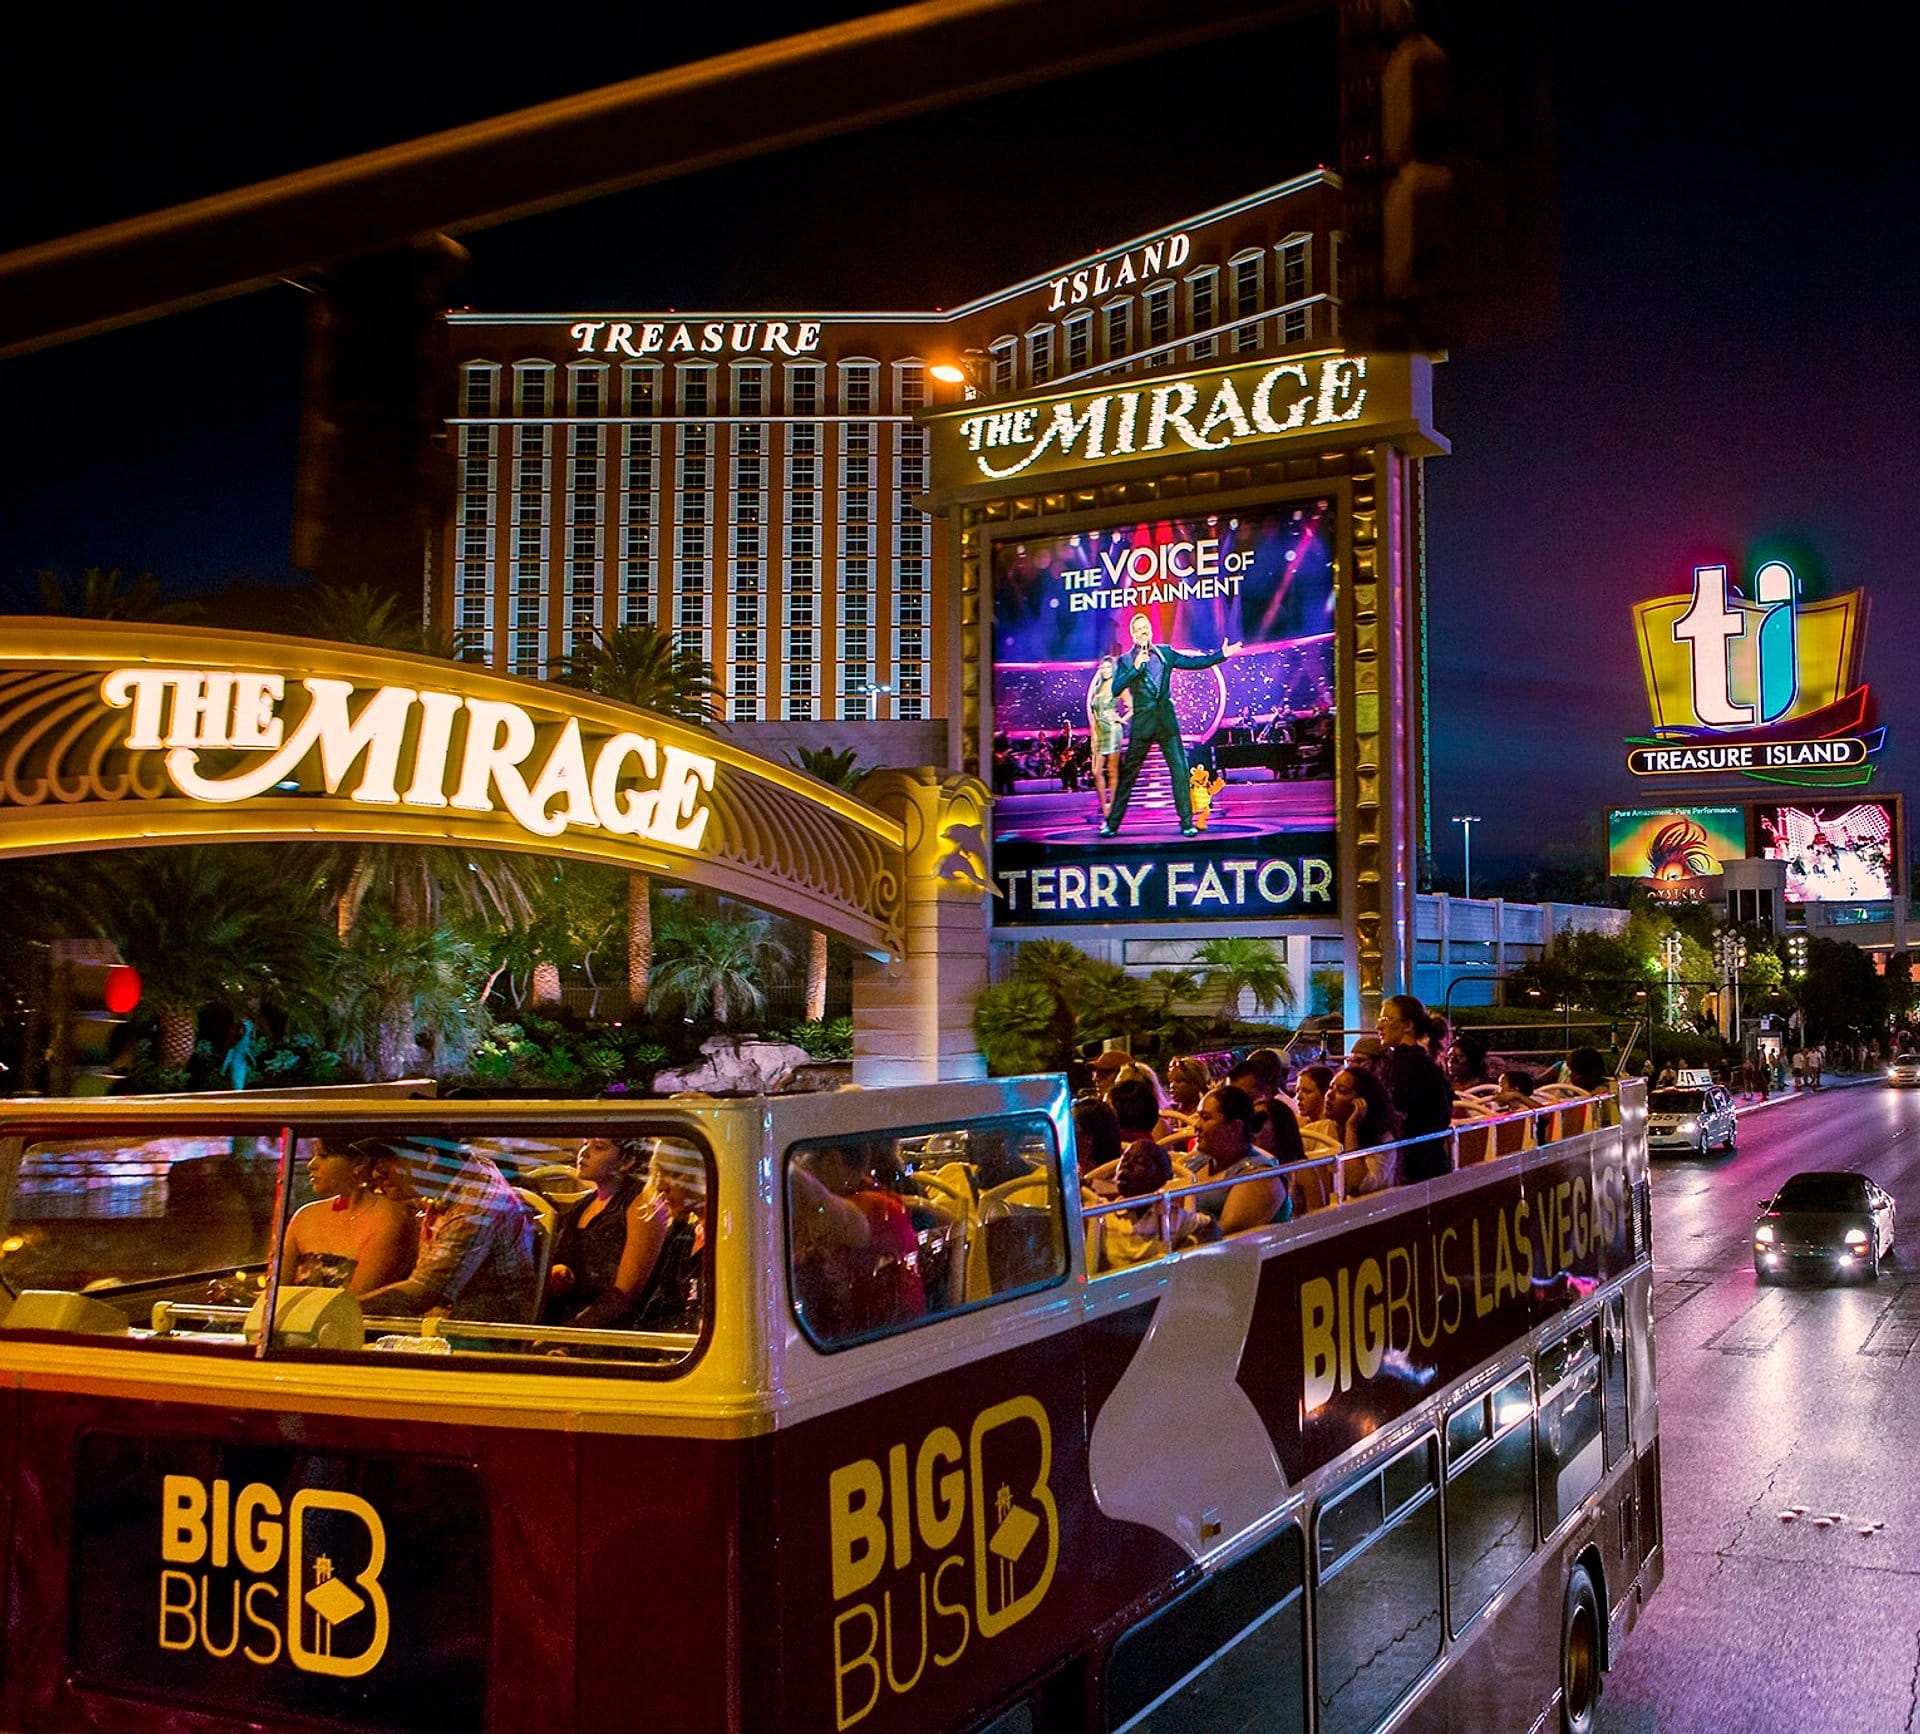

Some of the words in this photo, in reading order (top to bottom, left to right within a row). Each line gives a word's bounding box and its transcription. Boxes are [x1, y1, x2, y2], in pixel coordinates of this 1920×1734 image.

[571, 321, 822, 356] TREASURE
[1048, 233, 1192, 312] ISLAND
[960, 407, 1038, 451] THE
[977, 354, 1368, 479] MIRAGE
[1061, 566, 1102, 590] THE
[1100, 539, 1220, 584] VOICE
[1223, 550, 1255, 572] OF
[1070, 575, 1245, 613] ENTERTAINMENT
[101, 669, 286, 750] THE
[1643, 747, 1753, 771] TREASURE
[1766, 742, 1851, 766] ISLAND
[164, 677, 716, 851] MIRAGE
[998, 863, 1153, 911] TERRY
[1167, 856, 1333, 907] FATOR
[1473, 1199, 1534, 1319] LAS
[1537, 1166, 1617, 1276] VEGAS
[162, 1474, 283, 1573] BIG
[830, 1426, 965, 1601] BIG
[159, 1569, 282, 1665] BUS
[834, 1554, 970, 1733] BUS
